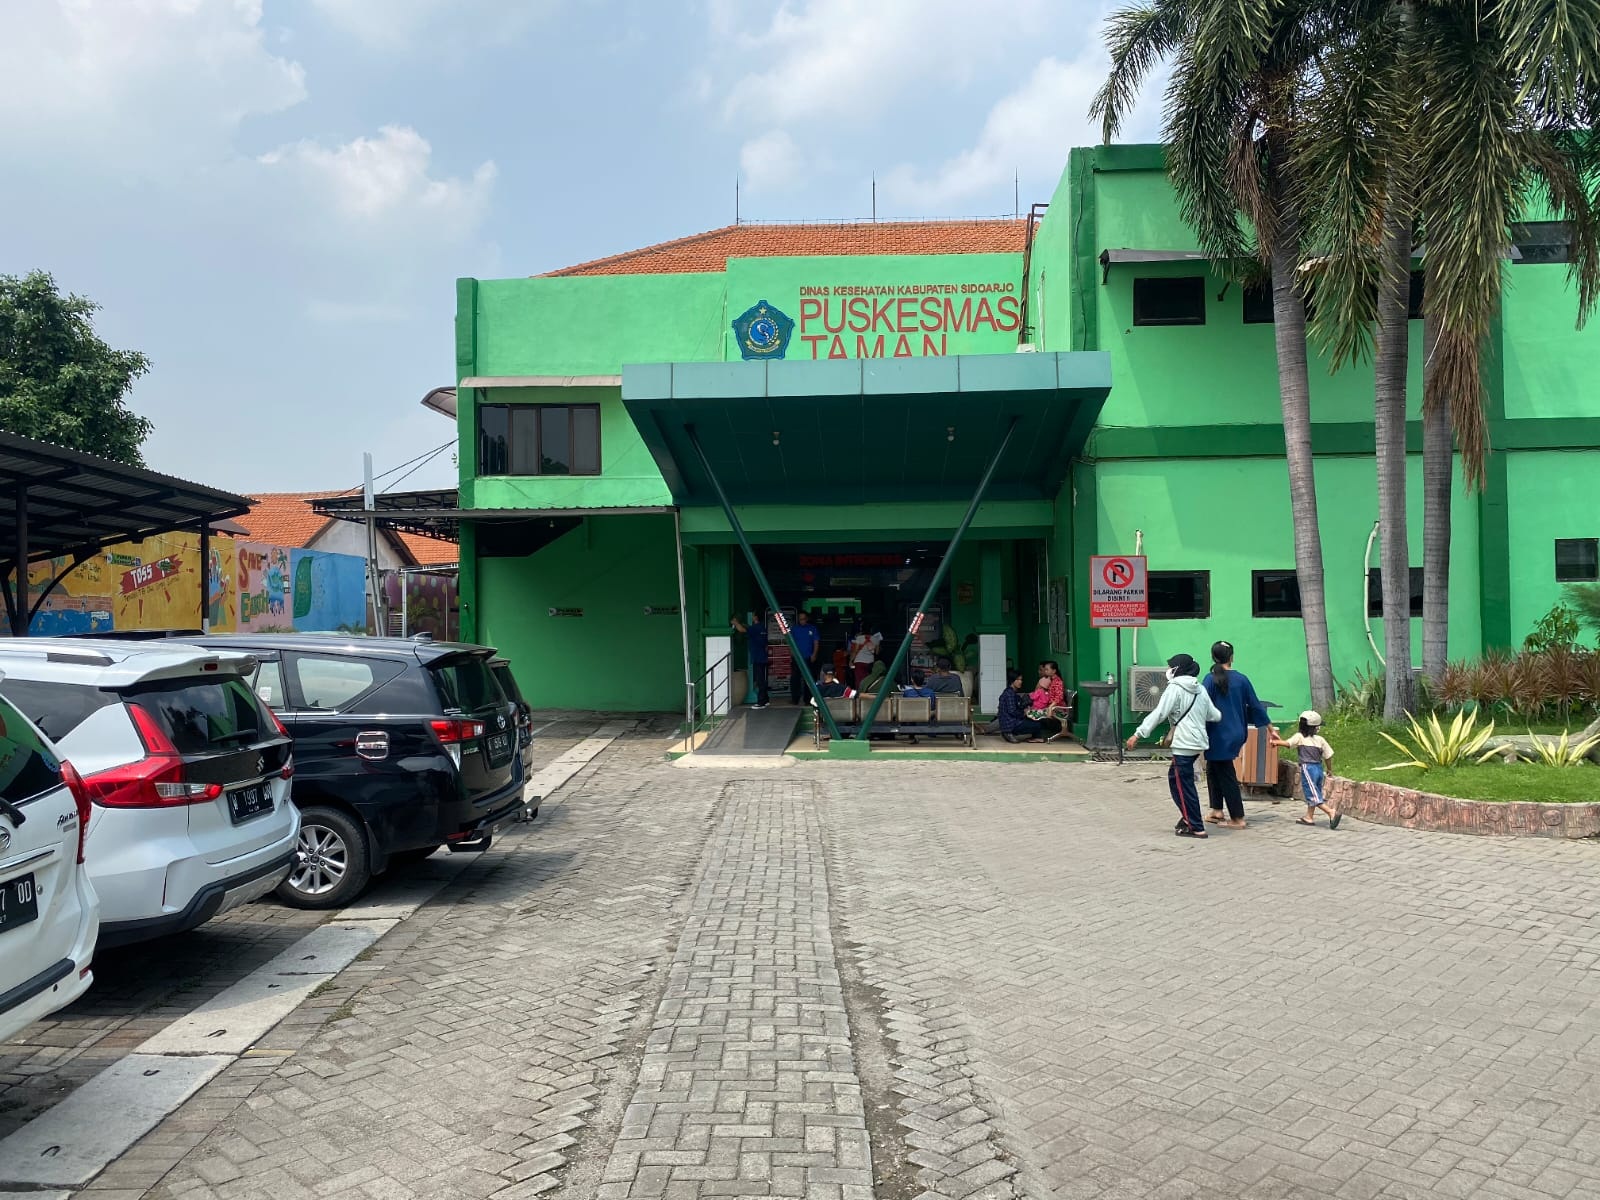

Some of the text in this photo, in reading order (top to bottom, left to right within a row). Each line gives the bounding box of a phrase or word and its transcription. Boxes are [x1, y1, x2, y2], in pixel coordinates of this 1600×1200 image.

[800, 282, 1015, 296] DINAS KESEHATAN KABUPATEN SIDOARJO
[800, 296, 1020, 333] PUSKESMAS
[801, 333, 947, 360] TAMAN
[130, 564, 153, 588] TOSS
